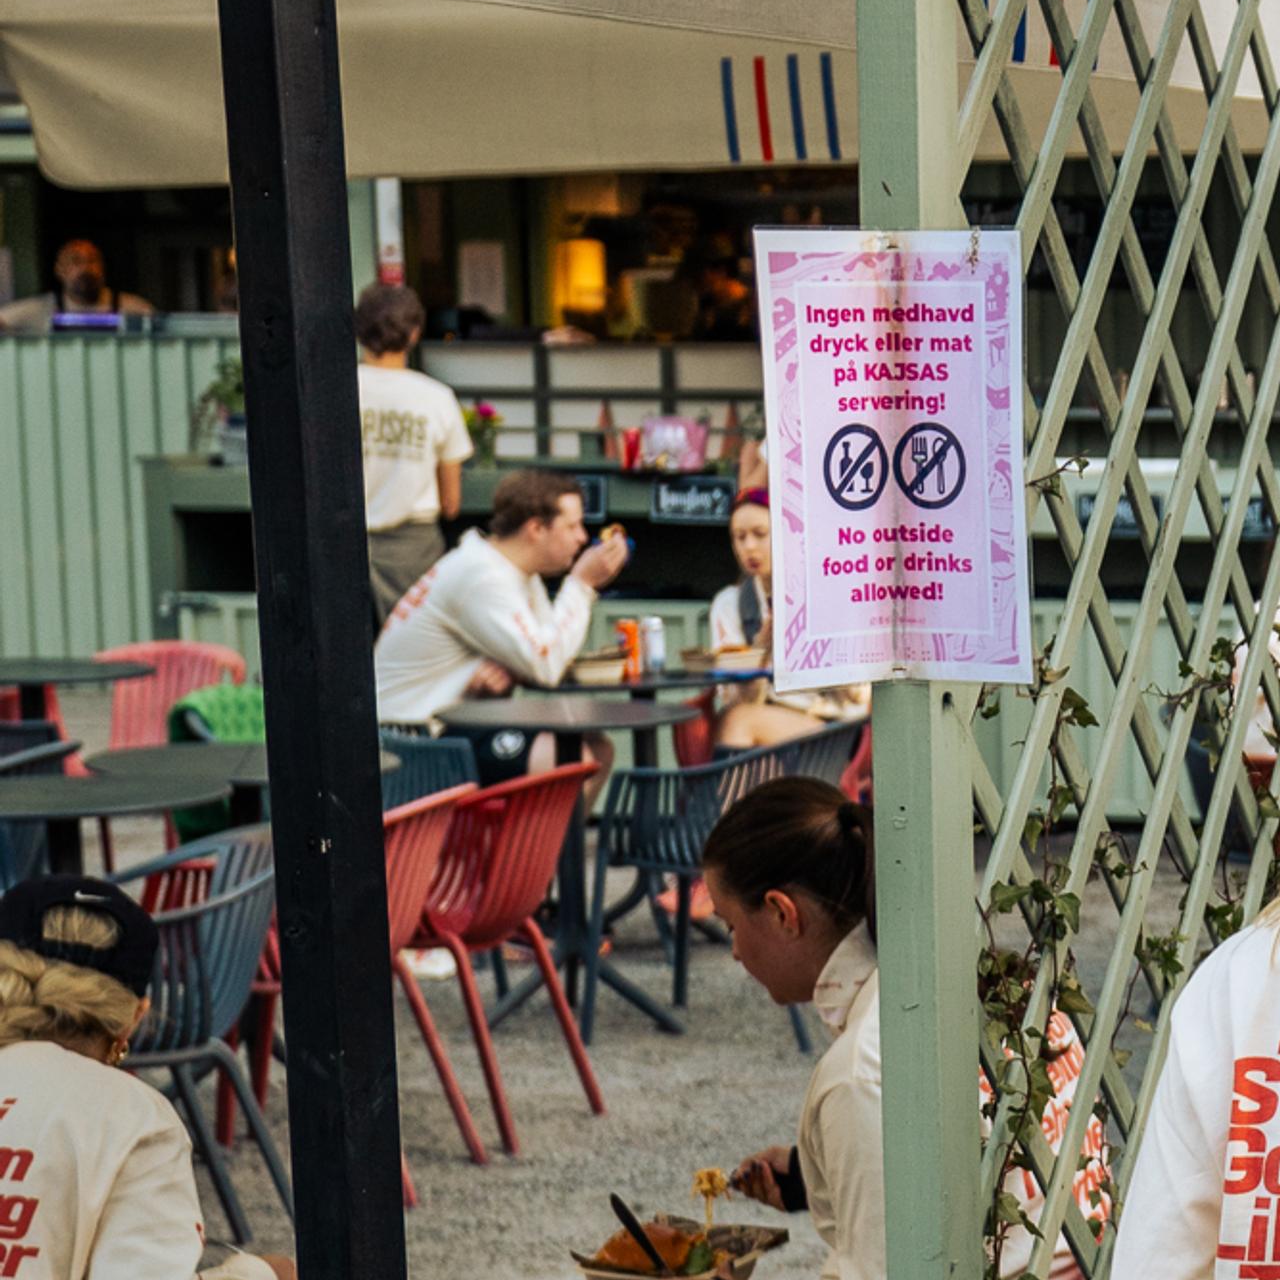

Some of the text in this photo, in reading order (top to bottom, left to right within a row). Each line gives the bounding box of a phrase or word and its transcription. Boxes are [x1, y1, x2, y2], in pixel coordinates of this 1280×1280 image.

[806, 302, 975, 326] Ingen medhavd
[809, 333, 972, 358] dryck eller mat
[834, 360, 949, 387] på KAJSAS
[838, 390, 946, 415] servering!
[838, 522, 954, 545] No outside
[822, 551, 973, 576] food or drinks
[850, 581, 944, 603] allowed!
